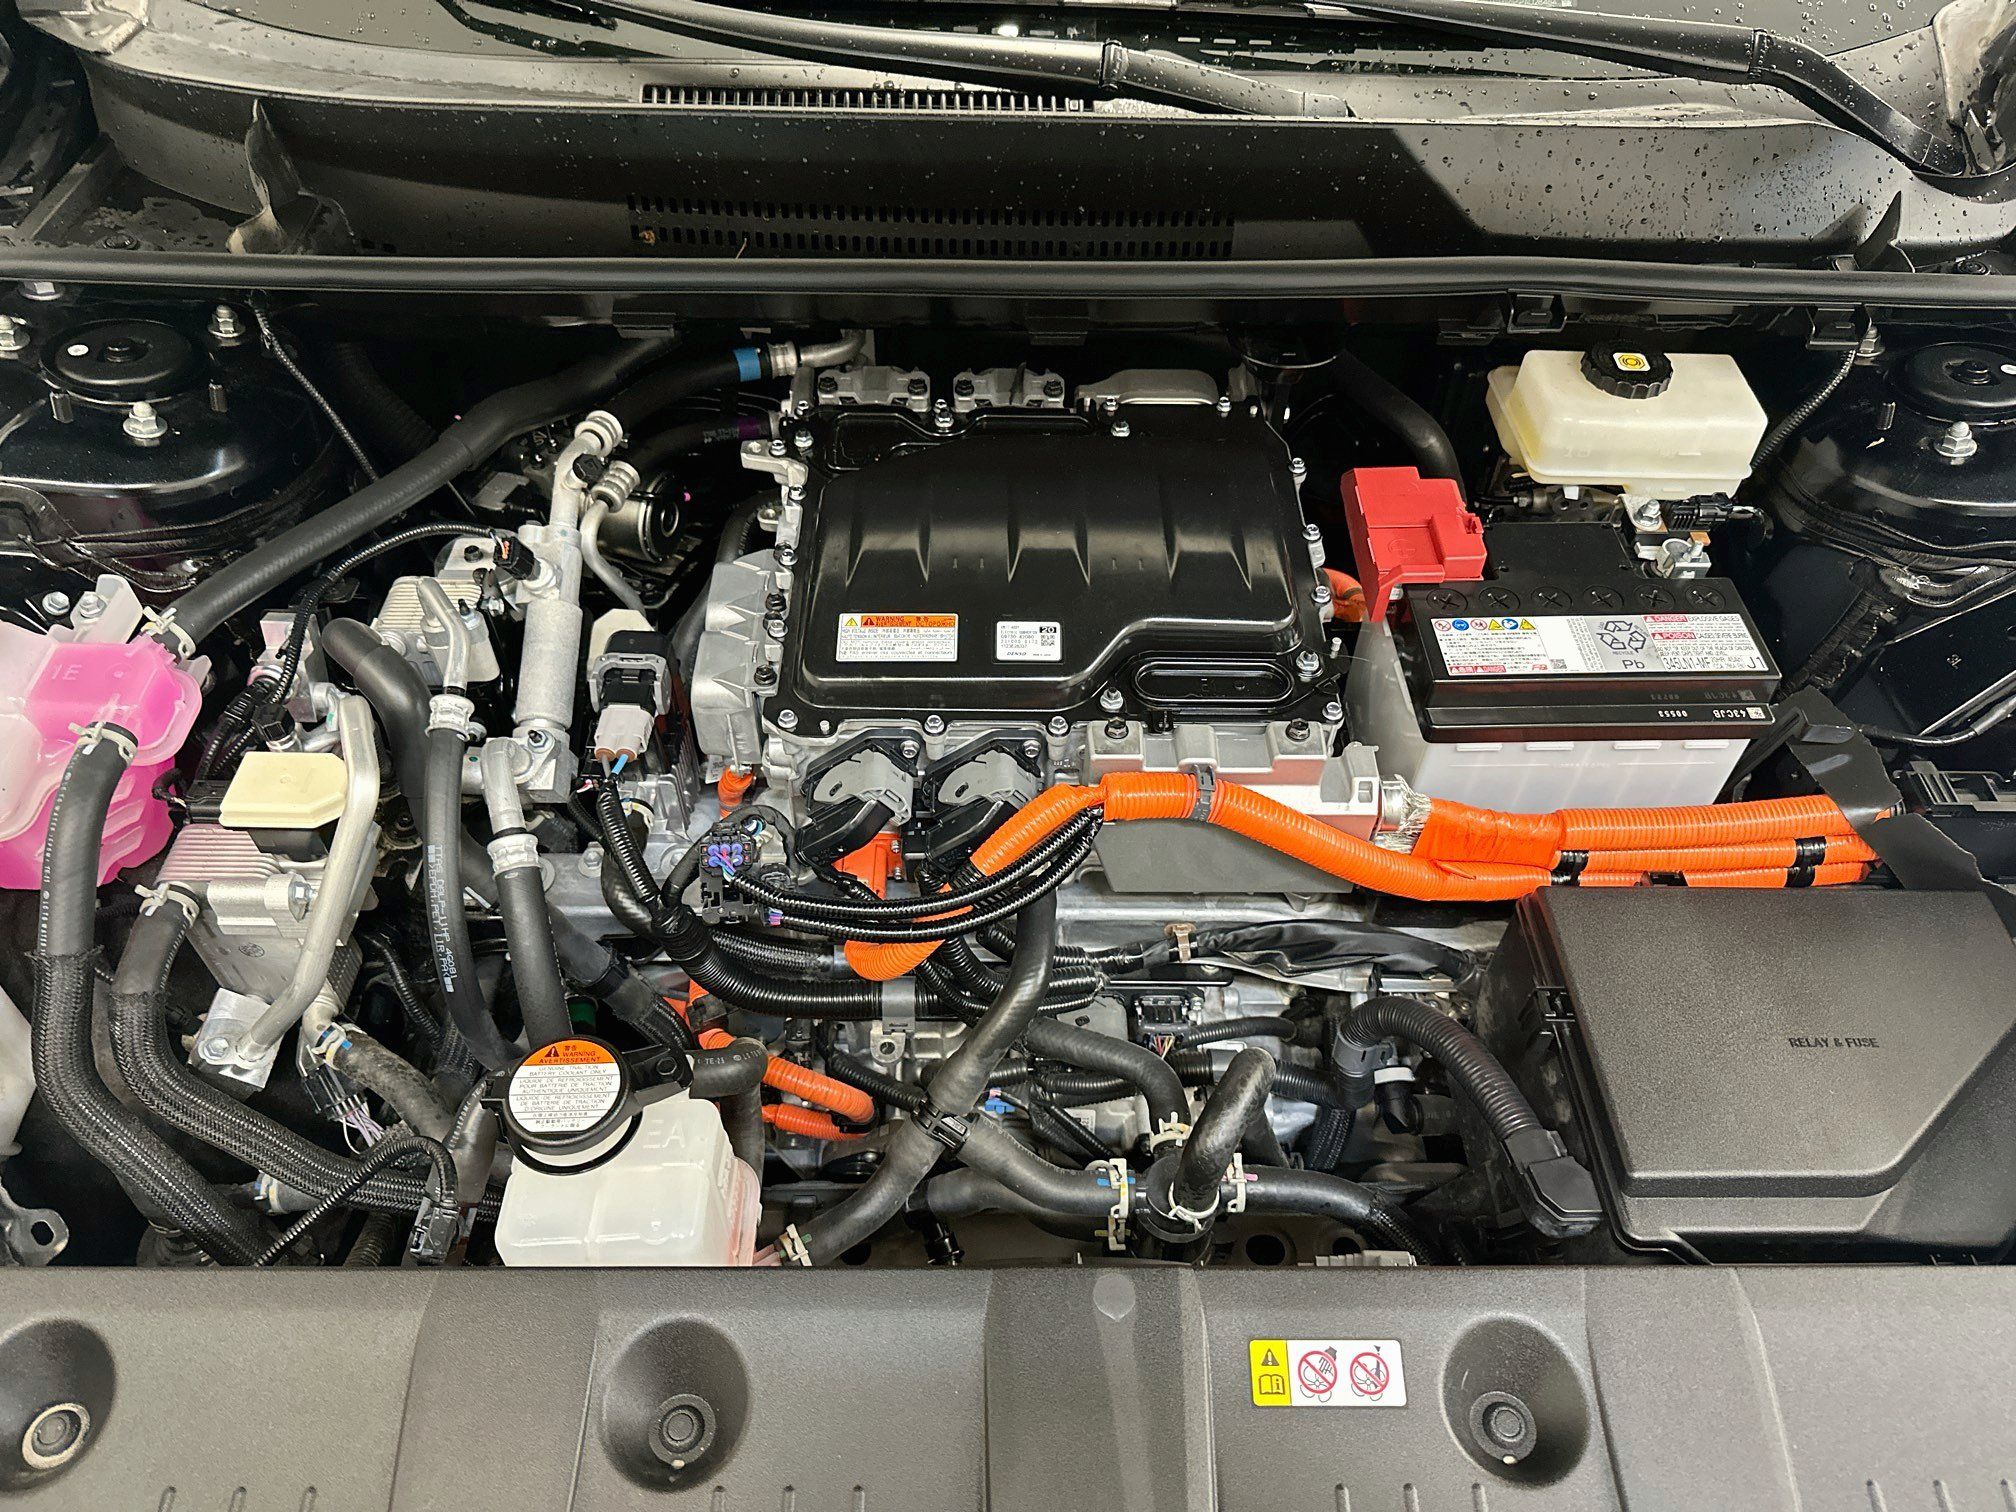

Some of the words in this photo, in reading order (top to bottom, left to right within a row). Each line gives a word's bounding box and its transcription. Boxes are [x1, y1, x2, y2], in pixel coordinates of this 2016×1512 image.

[1622, 660, 1645, 669] Pb
[1789, 1038, 1829, 1047] RELAY
[1834, 1038, 1844, 1047] &
[1845, 1038, 1880, 1047] FUSE
